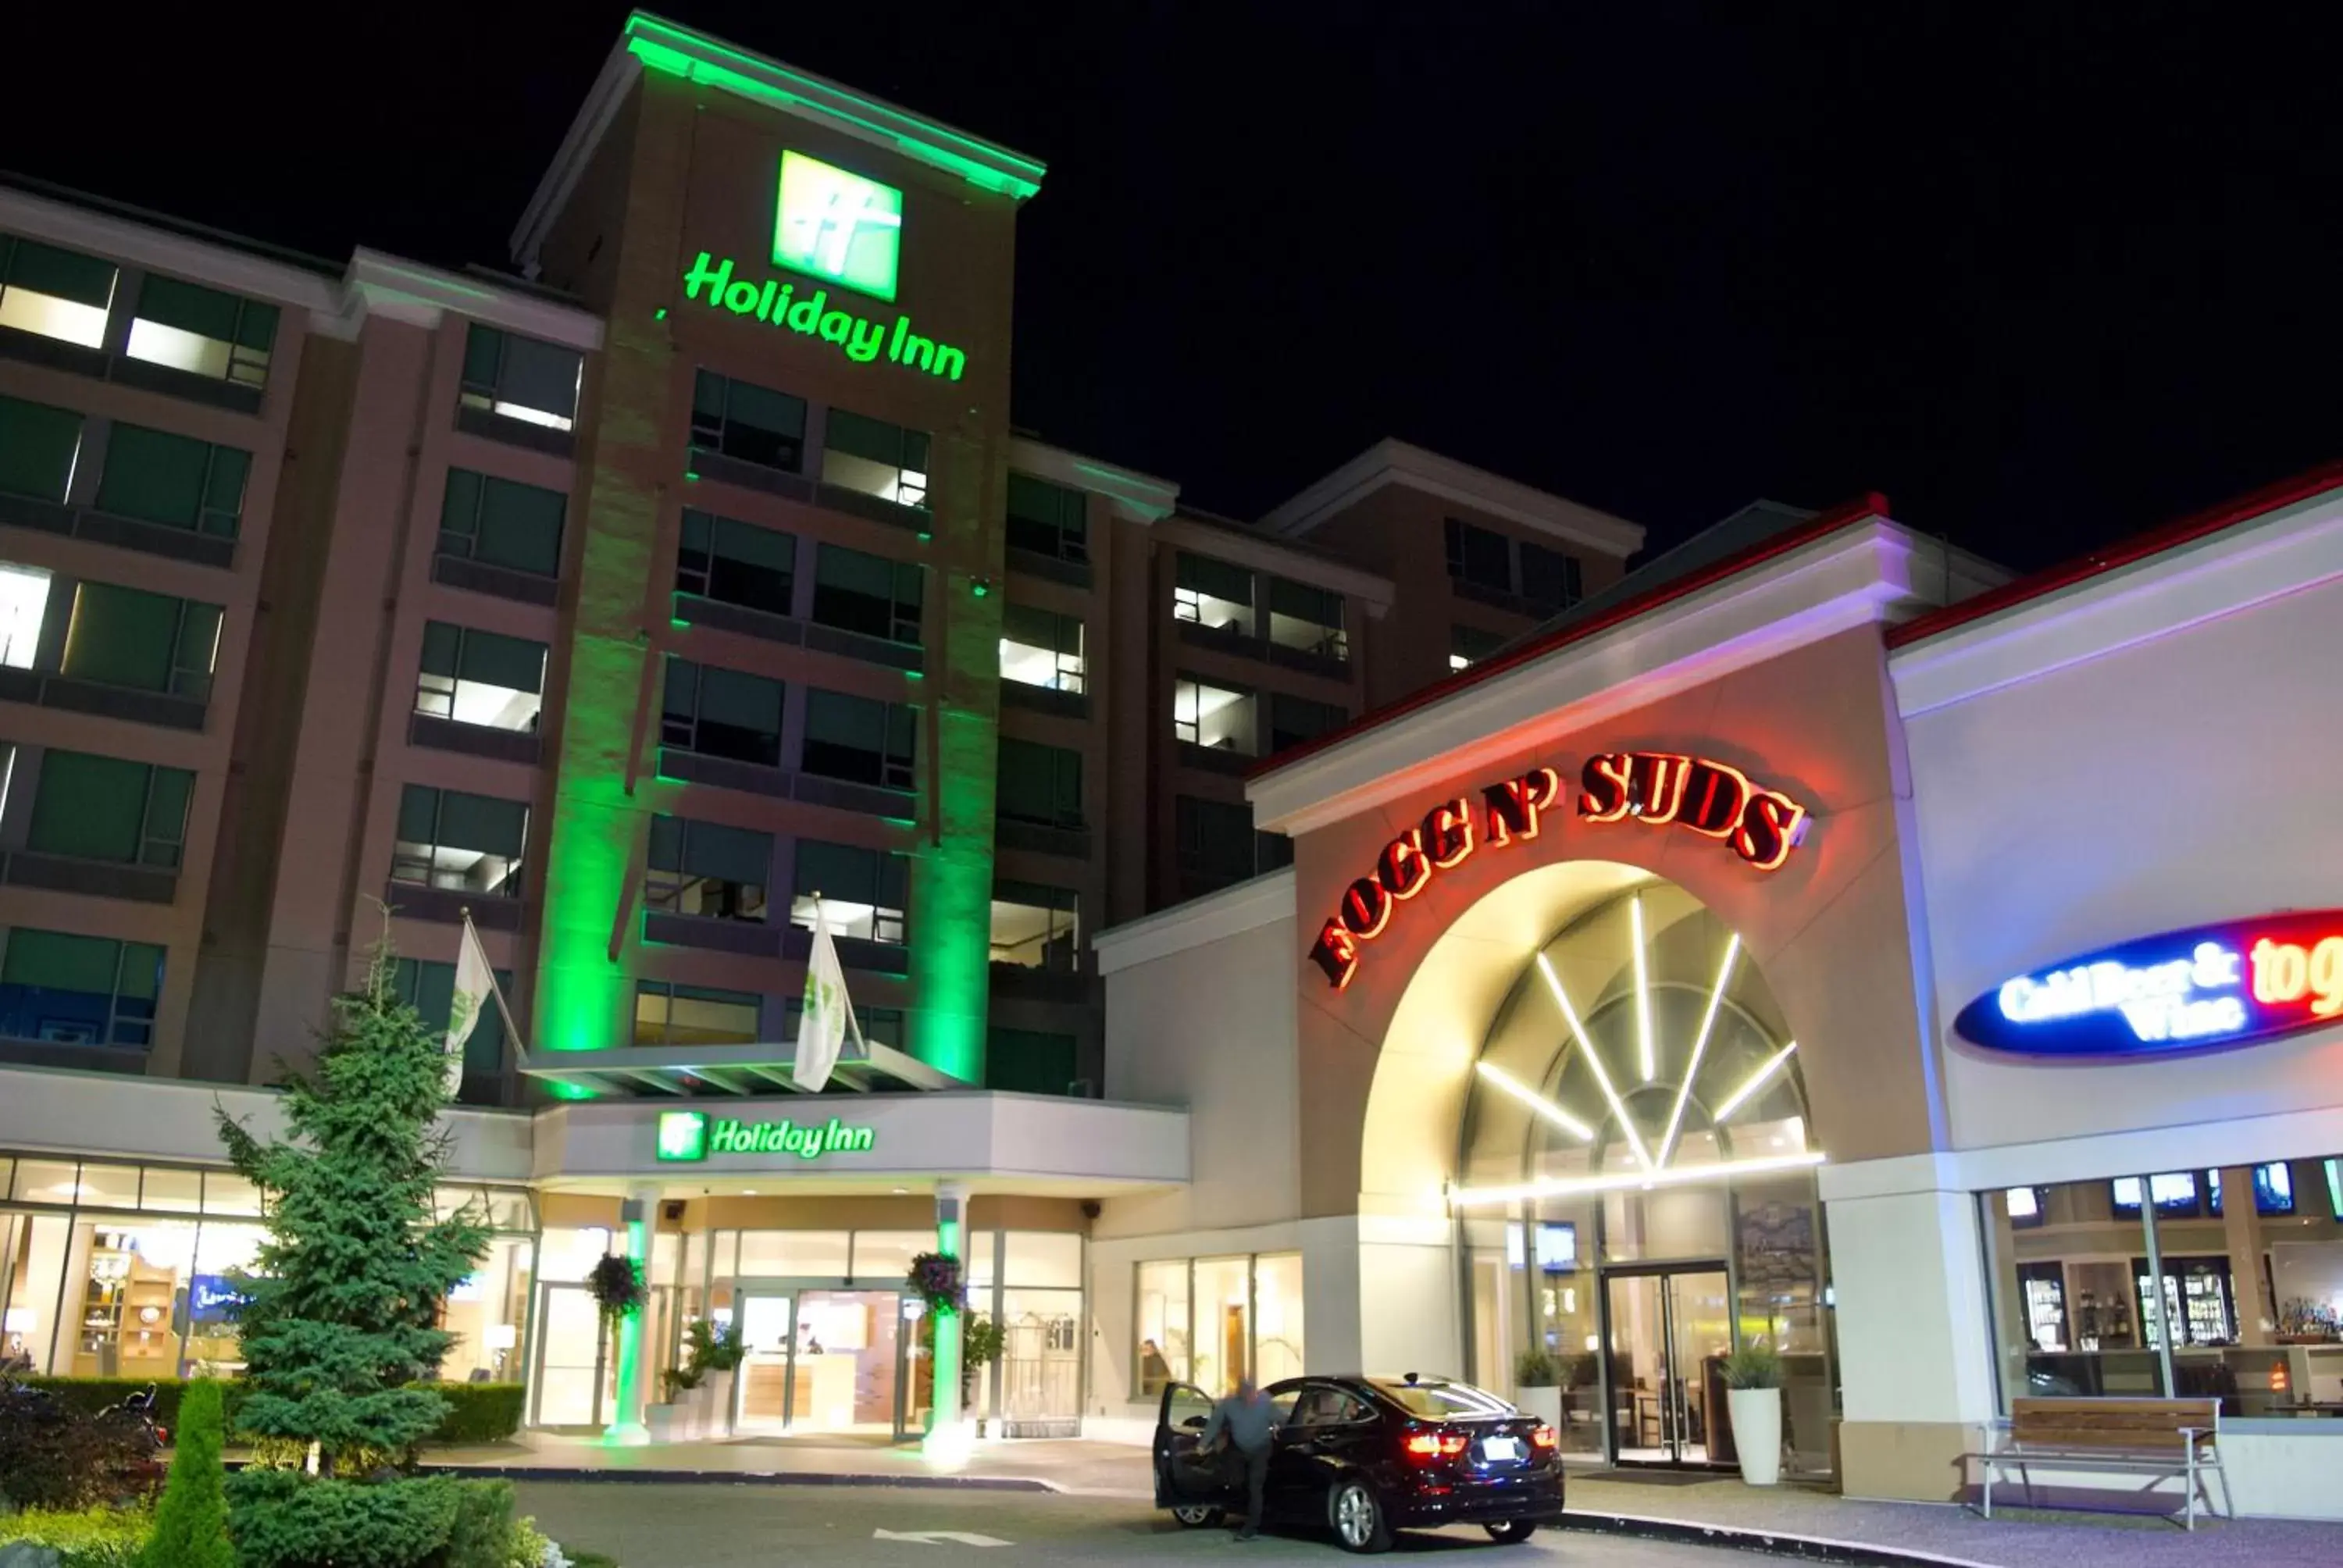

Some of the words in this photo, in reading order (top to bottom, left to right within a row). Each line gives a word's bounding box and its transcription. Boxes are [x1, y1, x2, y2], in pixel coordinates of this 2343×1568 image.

[684, 251, 885, 362] Holiday
[889, 315, 966, 381] Inn
[1308, 797, 1475, 992] FOGG
[1578, 750, 1805, 871] SUDS
[2191, 942, 2239, 987] &
[711, 1119, 823, 1159] Holiday
[825, 1117, 875, 1151] Inn
